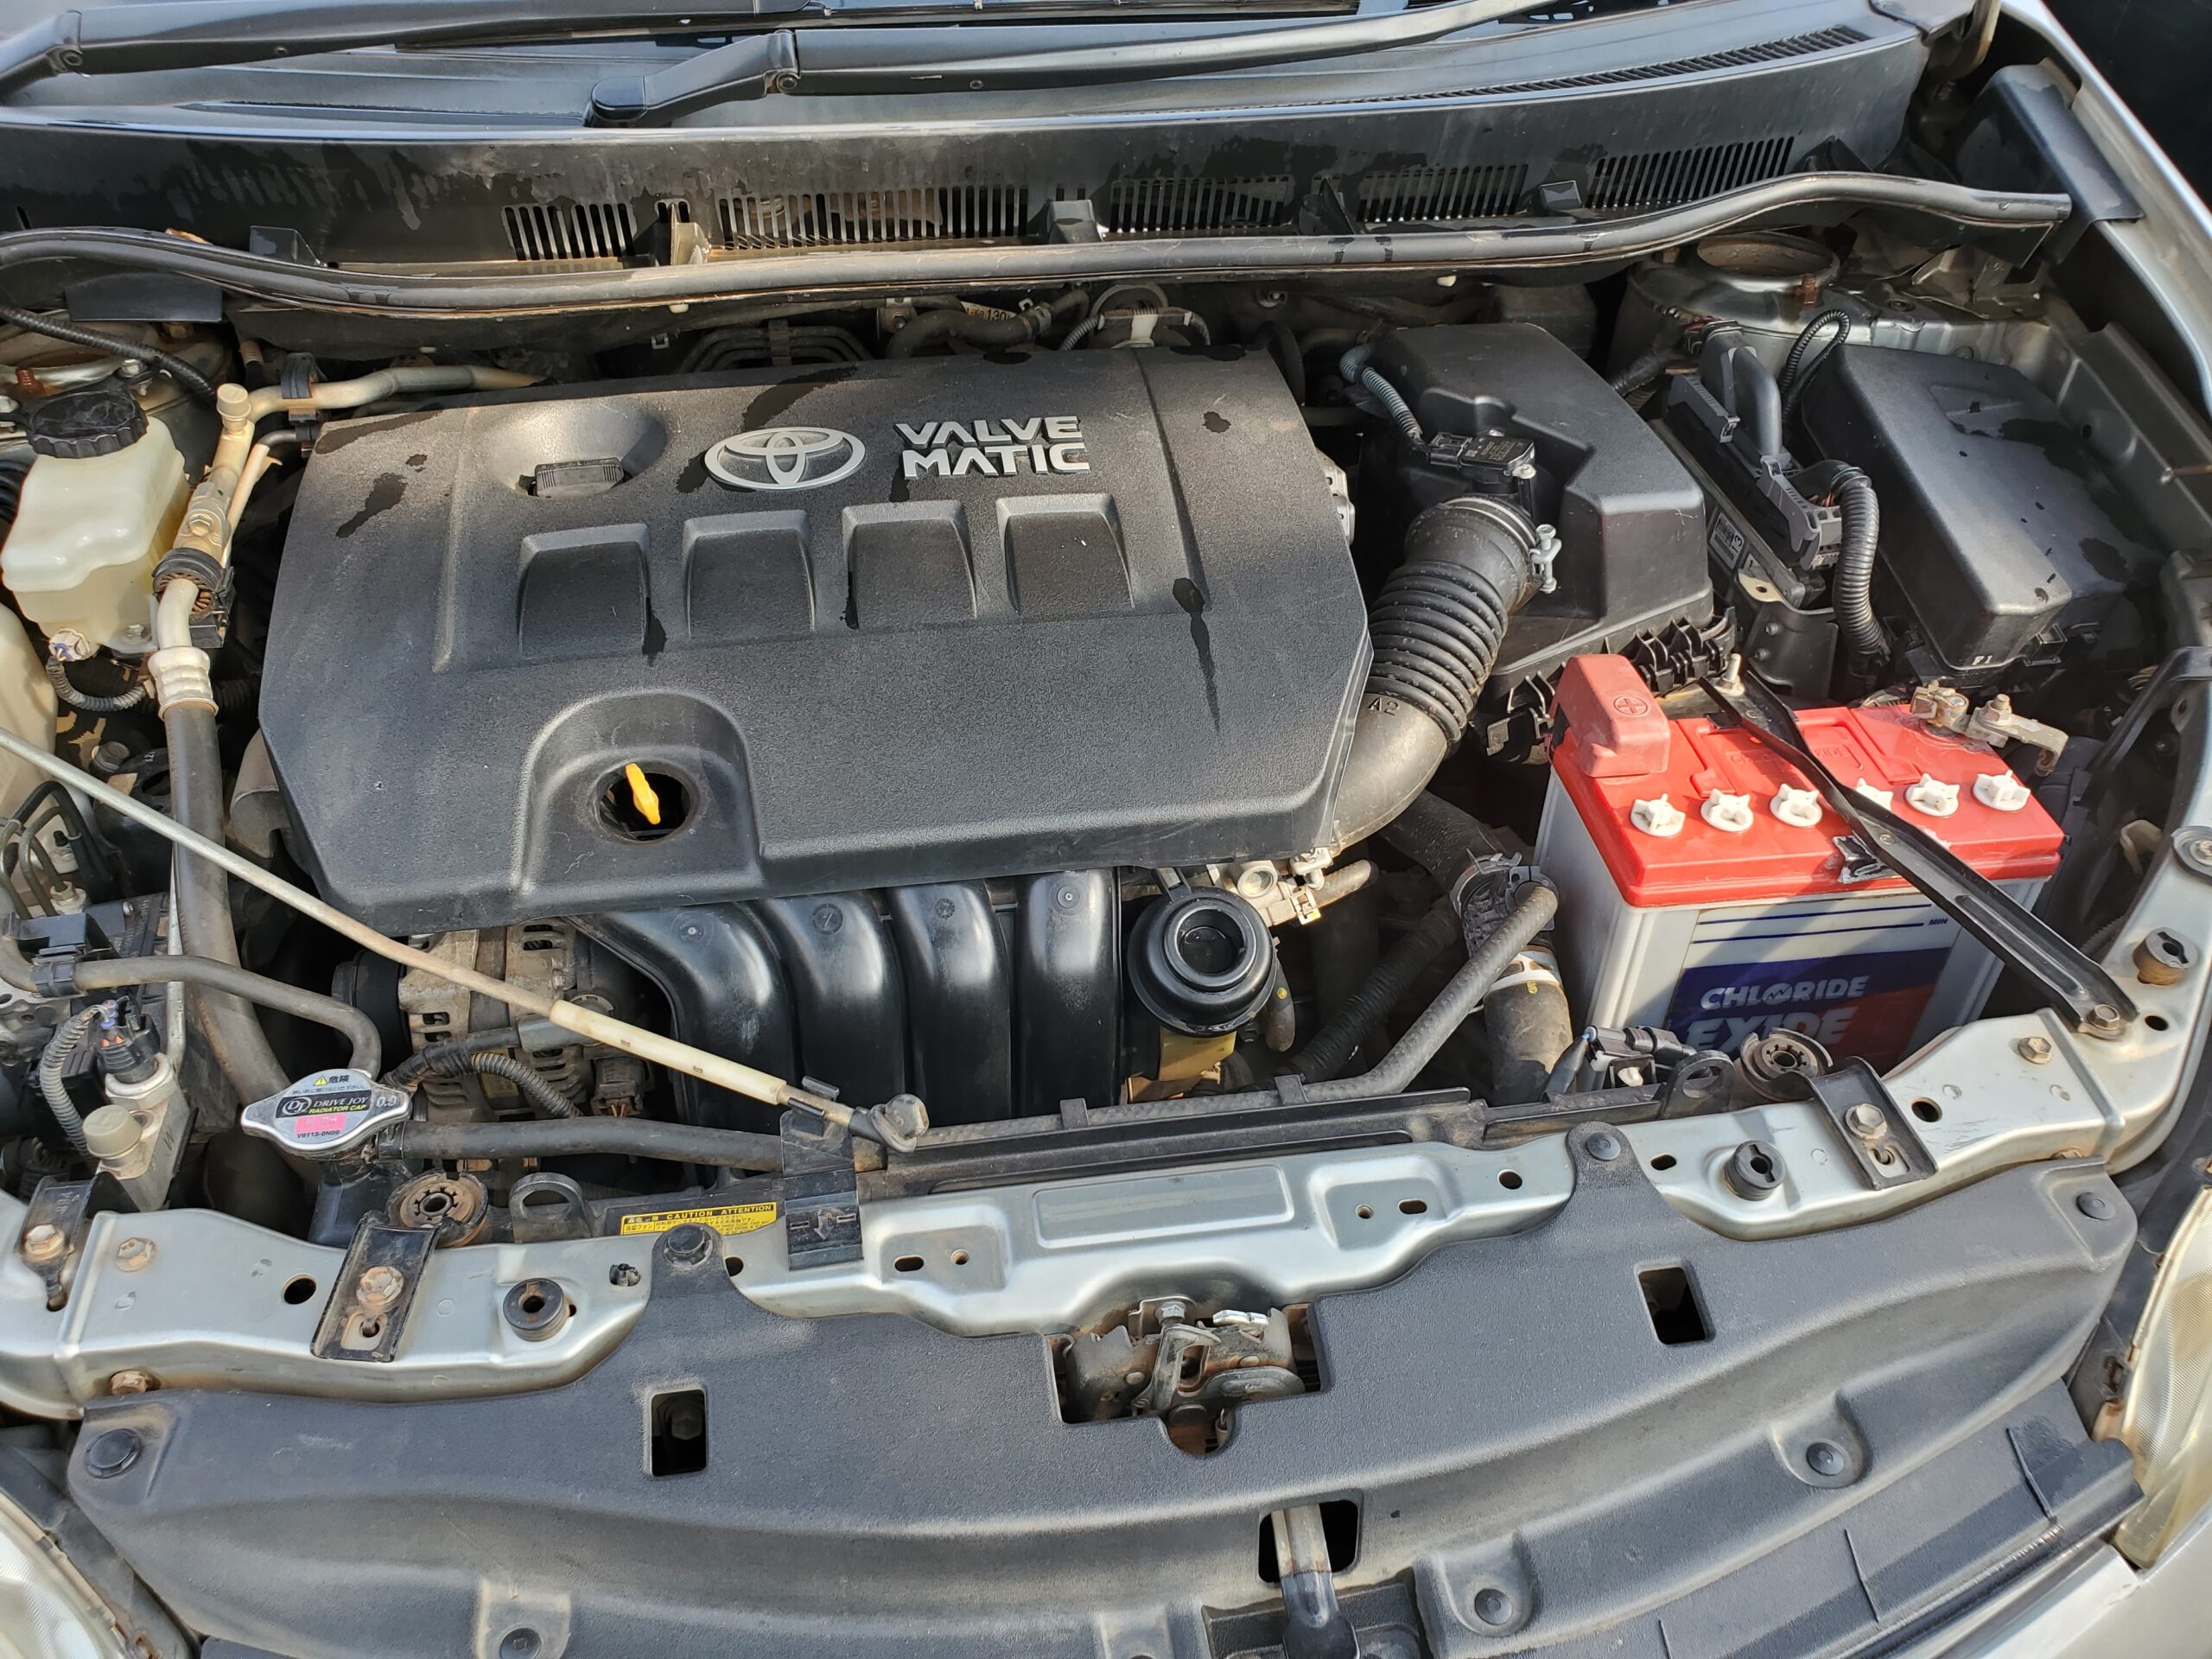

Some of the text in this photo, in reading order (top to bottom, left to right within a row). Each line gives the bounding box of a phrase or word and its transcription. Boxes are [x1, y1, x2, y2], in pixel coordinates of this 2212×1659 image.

[894, 416, 1084, 447] VALVE
[902, 442, 1090, 479] MATIC
[1368, 697, 1399, 716] A2
[1929, 918, 1948, 926] MIN
[1700, 976, 1870, 1010] CHLORIDE
[313, 1096, 370, 1108] DRIVE JOY
[376, 1095, 397, 1108] 0.9
[308, 1105, 348, 1115] RADIATOR
[666, 1210, 713, 1220] CAUTION
[721, 1205, 772, 1215] ATTENTION
